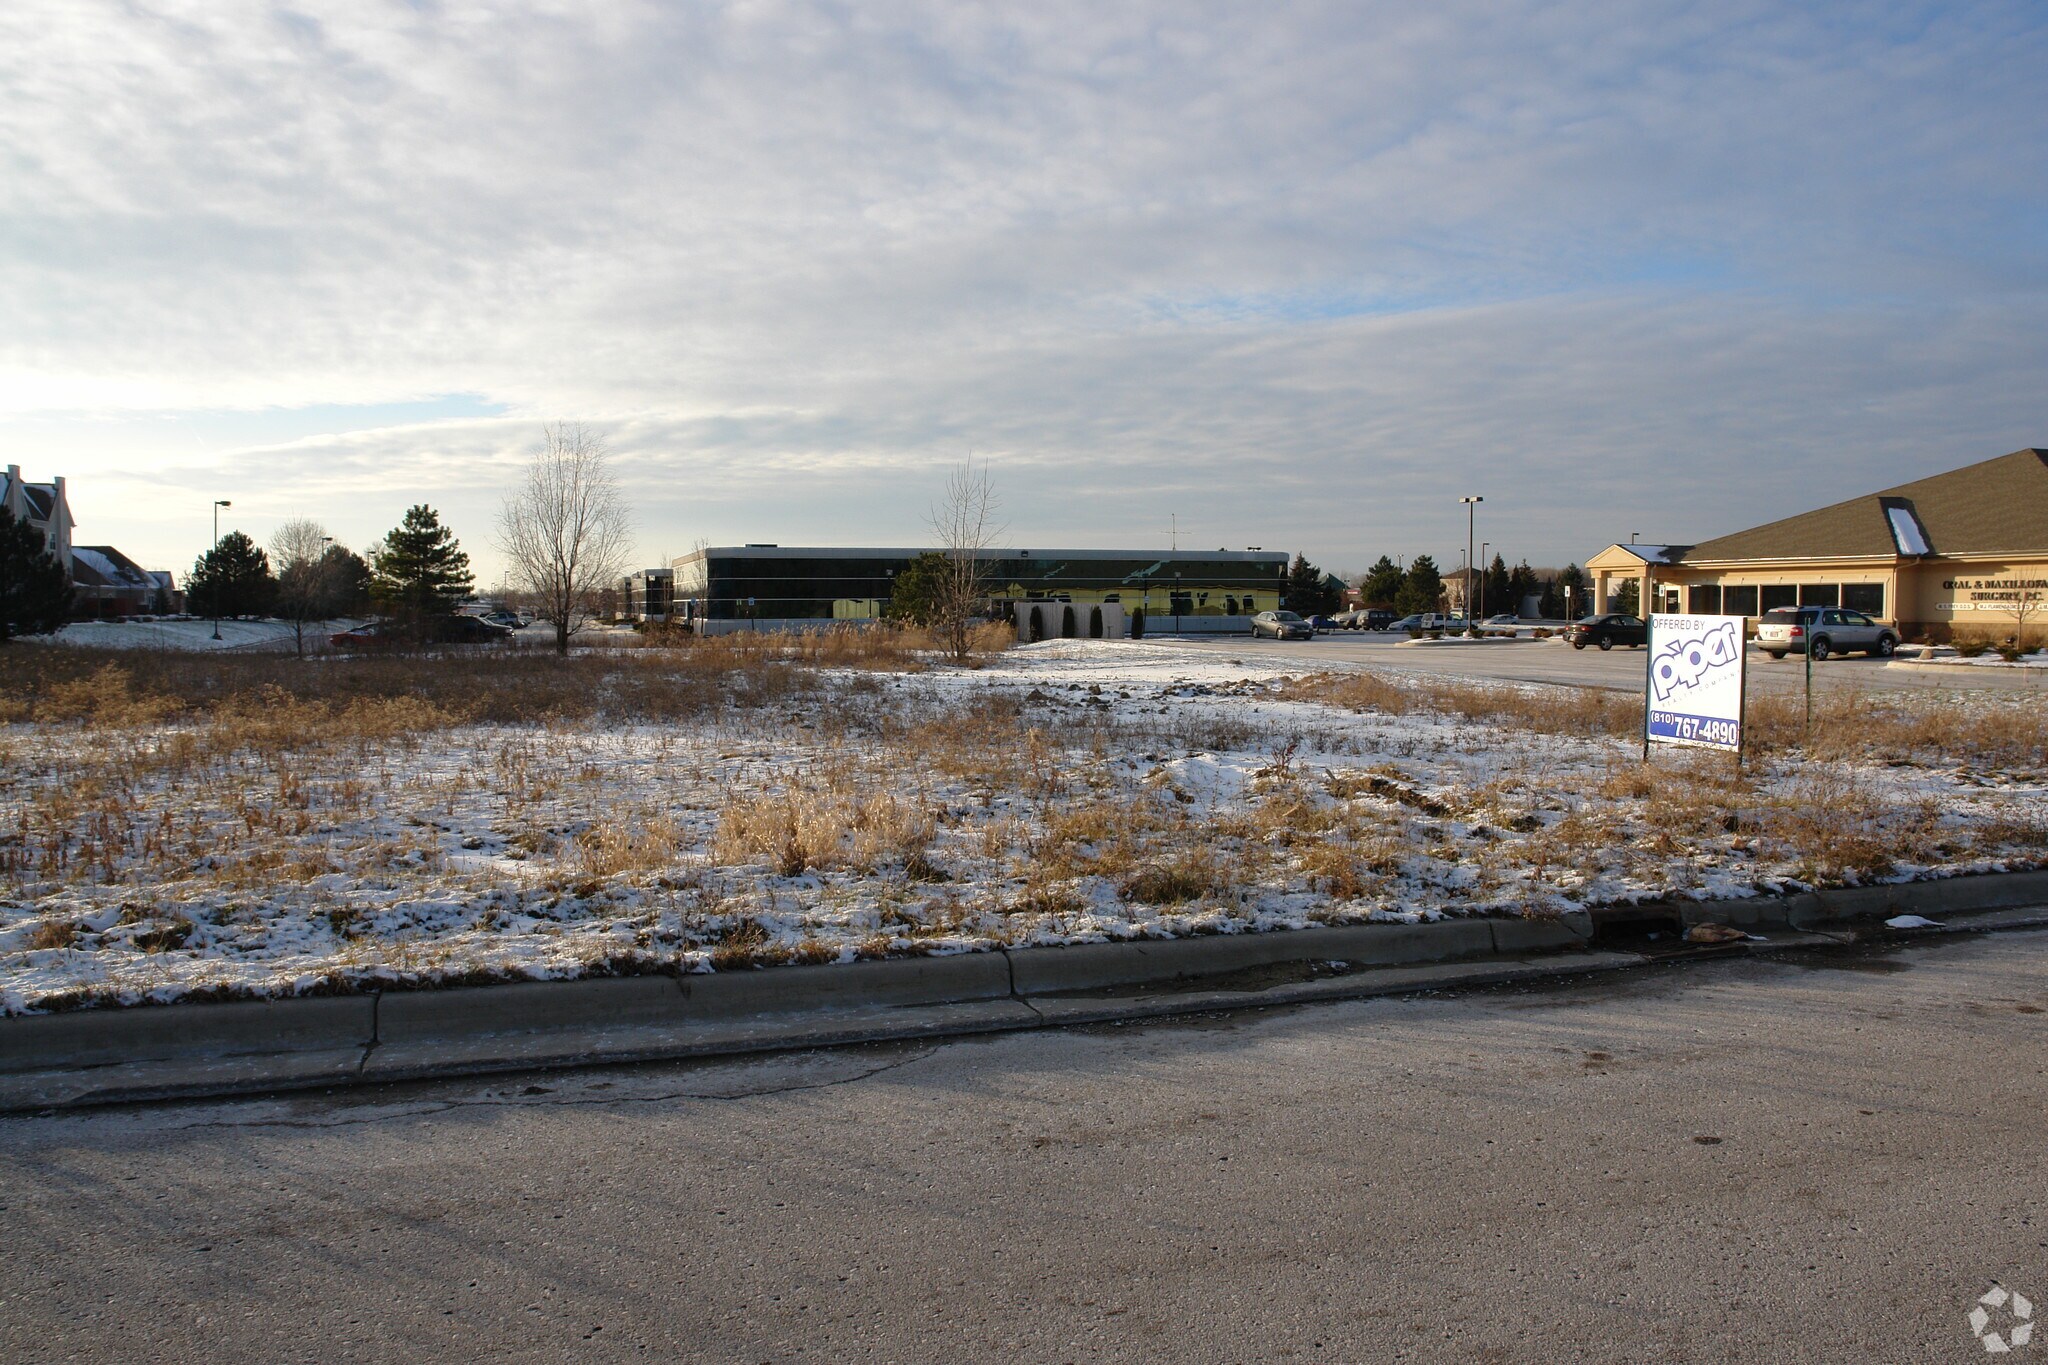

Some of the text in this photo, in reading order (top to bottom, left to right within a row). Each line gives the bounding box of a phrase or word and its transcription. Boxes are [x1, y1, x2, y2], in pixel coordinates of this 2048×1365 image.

[1943, 580, 2048, 589] ORAL & MAXILLOFA
[1653, 619, 1705, 630] OFFERED BY
[1651, 712, 1737, 745] (810) 767-4890
